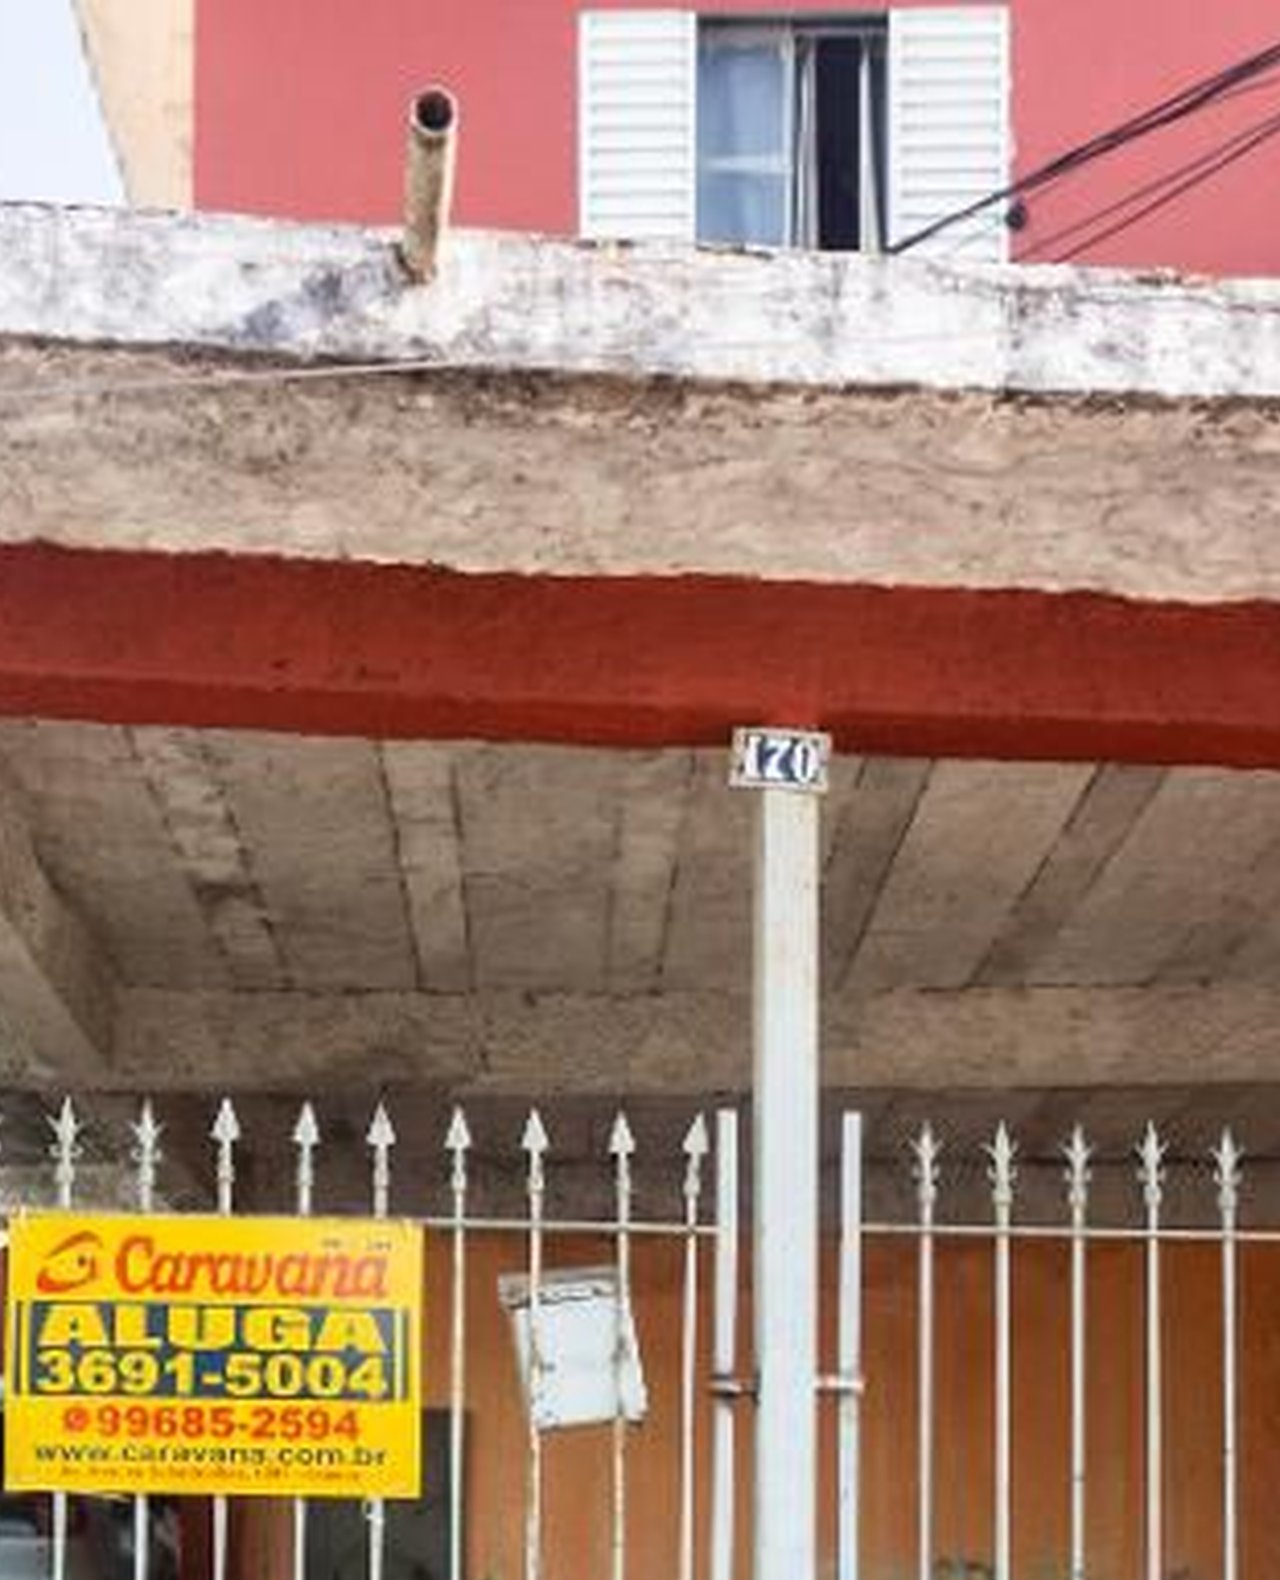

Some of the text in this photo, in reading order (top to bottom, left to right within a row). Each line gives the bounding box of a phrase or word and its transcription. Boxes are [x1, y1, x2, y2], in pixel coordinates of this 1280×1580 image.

[743, 734, 820, 783] 170
[115, 1234, 390, 1299] Caravana
[37, 1303, 389, 1354] ALUGA
[35, 1349, 388, 1397] 3691-5004
[96, 1404, 362, 1442] 99685-2594
[35, 1443, 388, 1467] www.caravana.com.br
